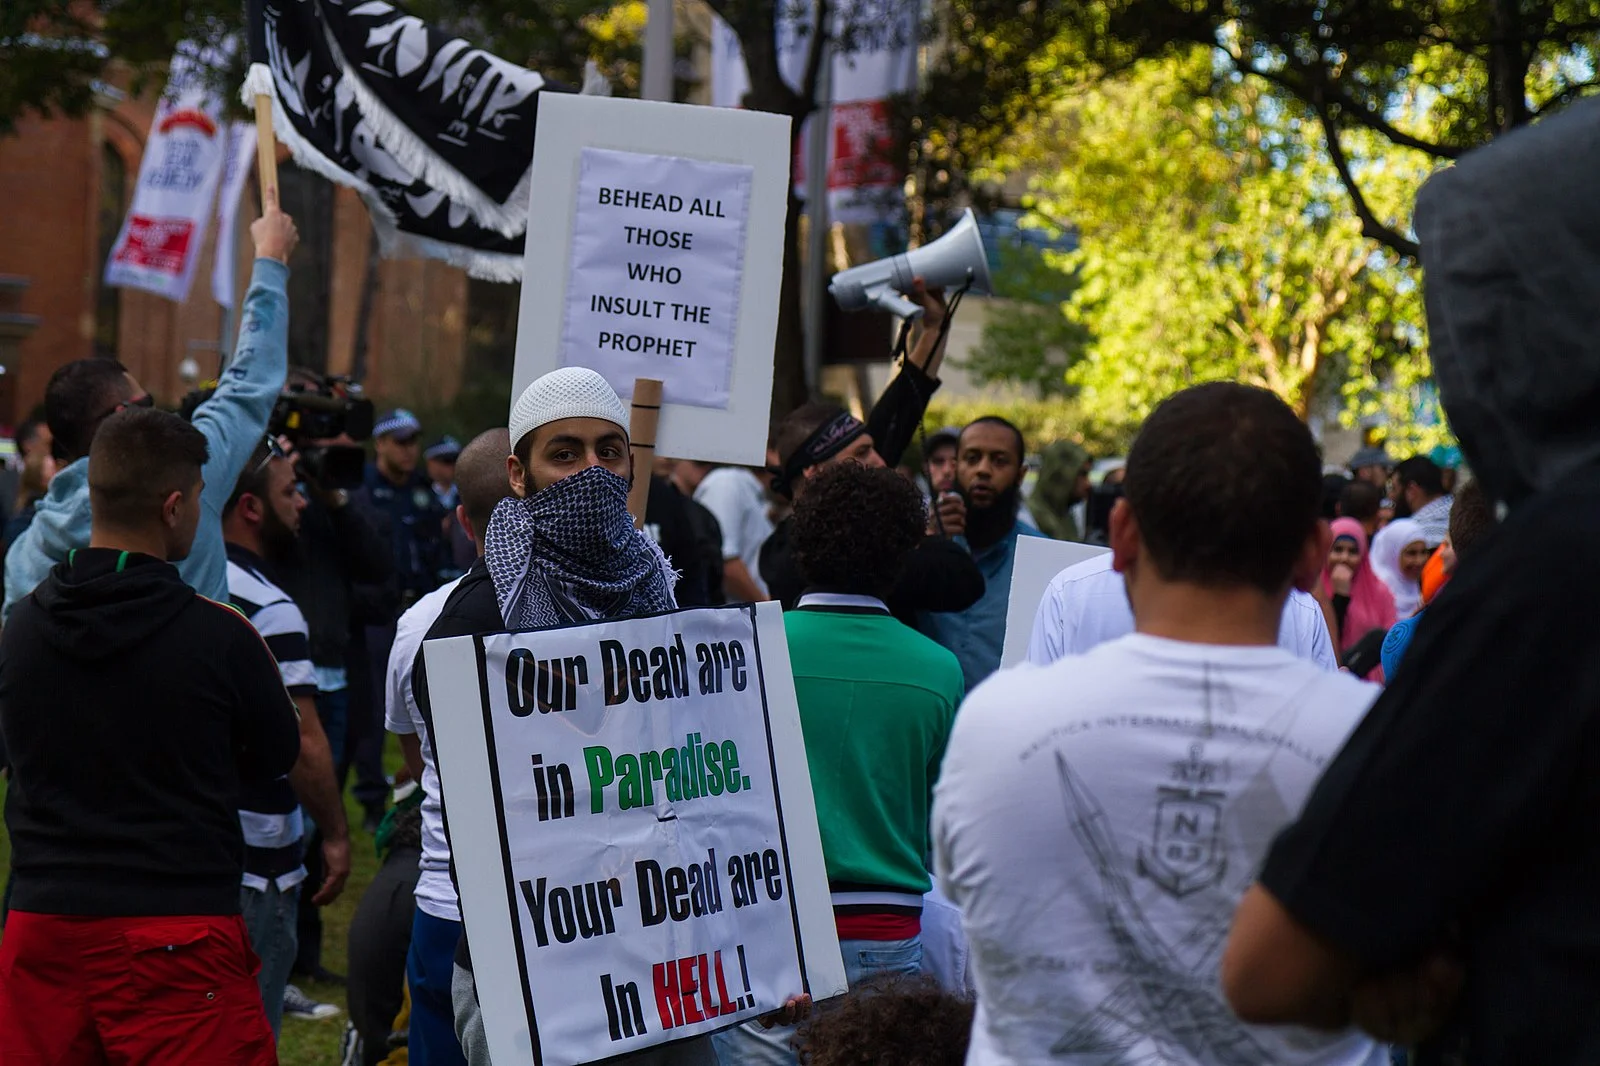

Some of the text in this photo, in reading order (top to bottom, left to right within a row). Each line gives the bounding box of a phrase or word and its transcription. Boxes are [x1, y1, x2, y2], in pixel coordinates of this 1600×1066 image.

[599, 187, 726, 218] BEHEAD ALL
[624, 226, 693, 251] THOSE
[627, 262, 682, 285] WHO
[591, 294, 711, 324] INSULT THE
[599, 331, 697, 358] PROPHET
[506, 634, 748, 717] Our Dead are
[532, 732, 752, 822] in Paradise.
[1173, 811, 1200, 836] N
[519, 848, 783, 947] Your Dead are
[600, 945, 756, 1041] In HELL.!
